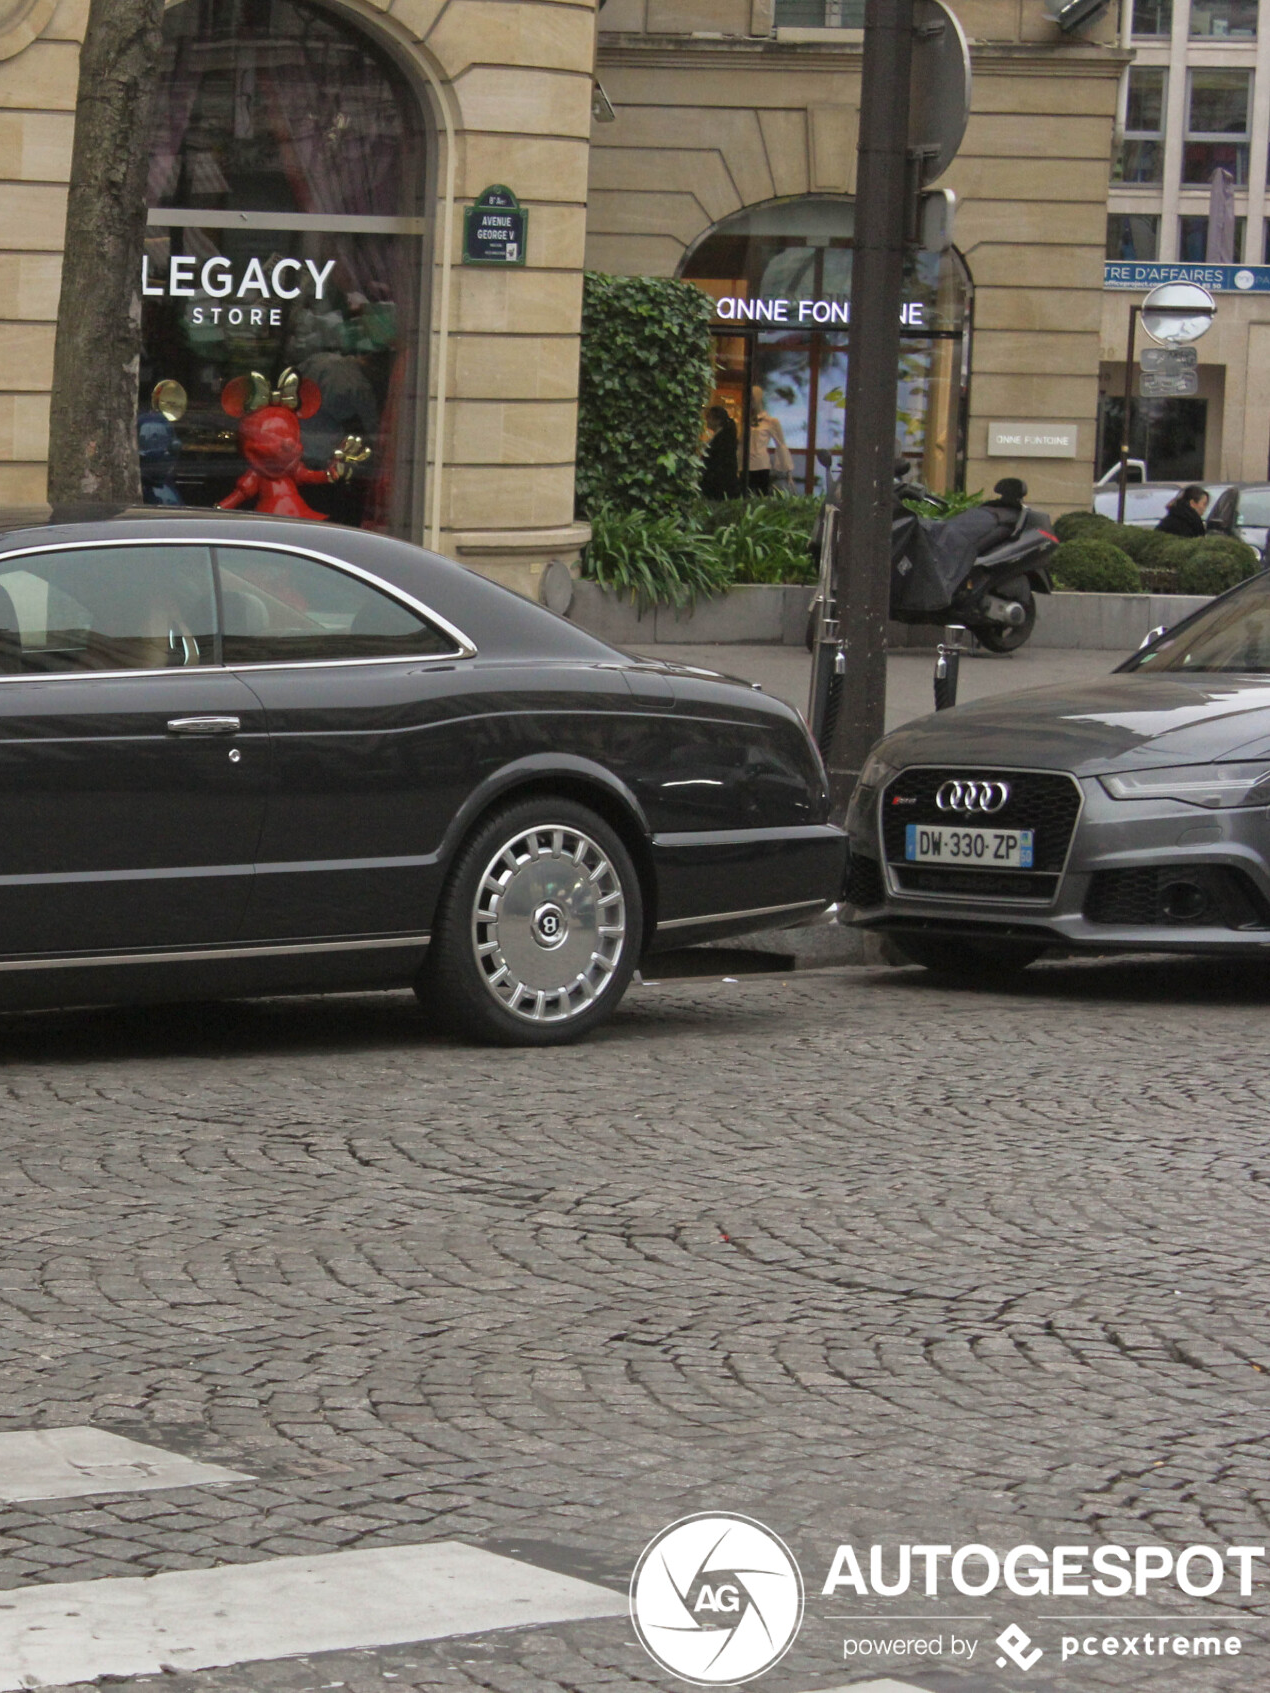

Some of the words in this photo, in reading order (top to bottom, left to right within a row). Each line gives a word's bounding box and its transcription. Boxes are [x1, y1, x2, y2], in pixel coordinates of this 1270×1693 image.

[482, 216, 512, 227] AVENUE
[477, 229, 508, 240] GEORGE
[509, 230, 515, 240] V
[142, 255, 336, 300] LEGACY
[1135, 267, 1223, 282] D'AFFAIRES
[192, 308, 282, 326] STORE
